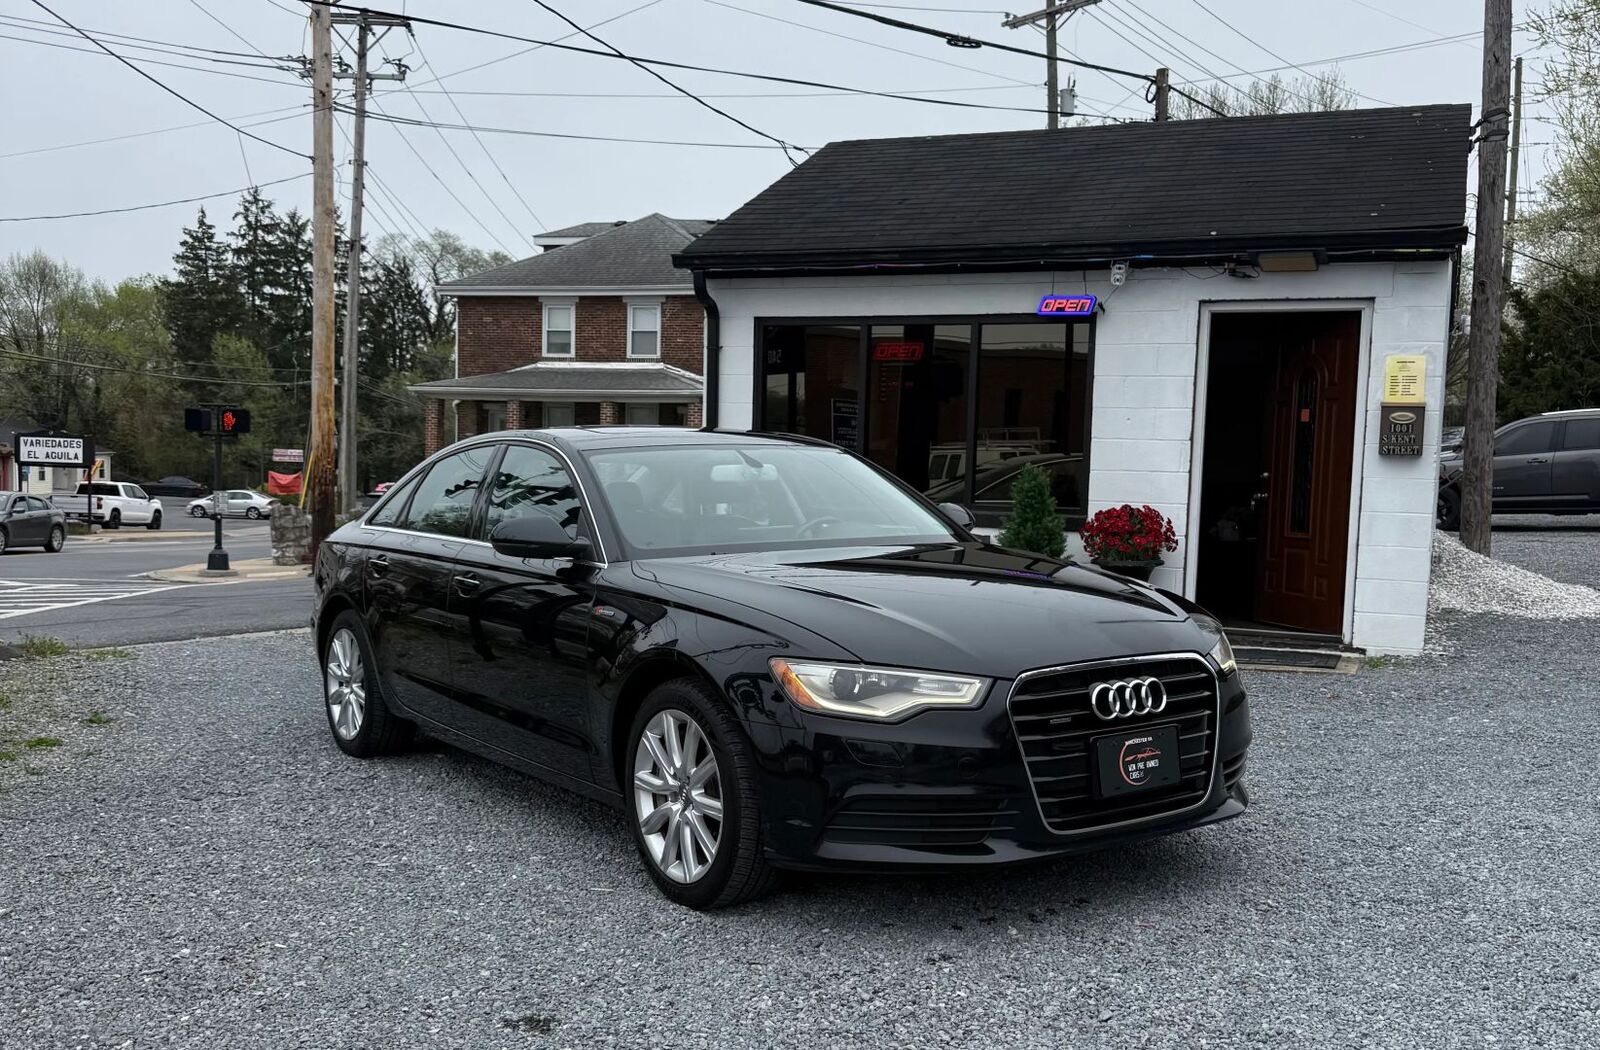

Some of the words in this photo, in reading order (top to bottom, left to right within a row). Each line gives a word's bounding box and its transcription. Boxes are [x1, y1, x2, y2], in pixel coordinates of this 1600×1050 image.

[1041, 299, 1091, 312] OPEN
[876, 345, 921, 359] OPEN
[1390, 424, 1412, 433] 1001
[22, 438, 82, 449] VARIEDADES
[1382, 434, 1389, 444] S
[1391, 434, 1416, 444] KENT
[27, 450, 40, 460] EL
[45, 451, 79, 461] AGUILA
[1382, 445, 1420, 455] STREET
